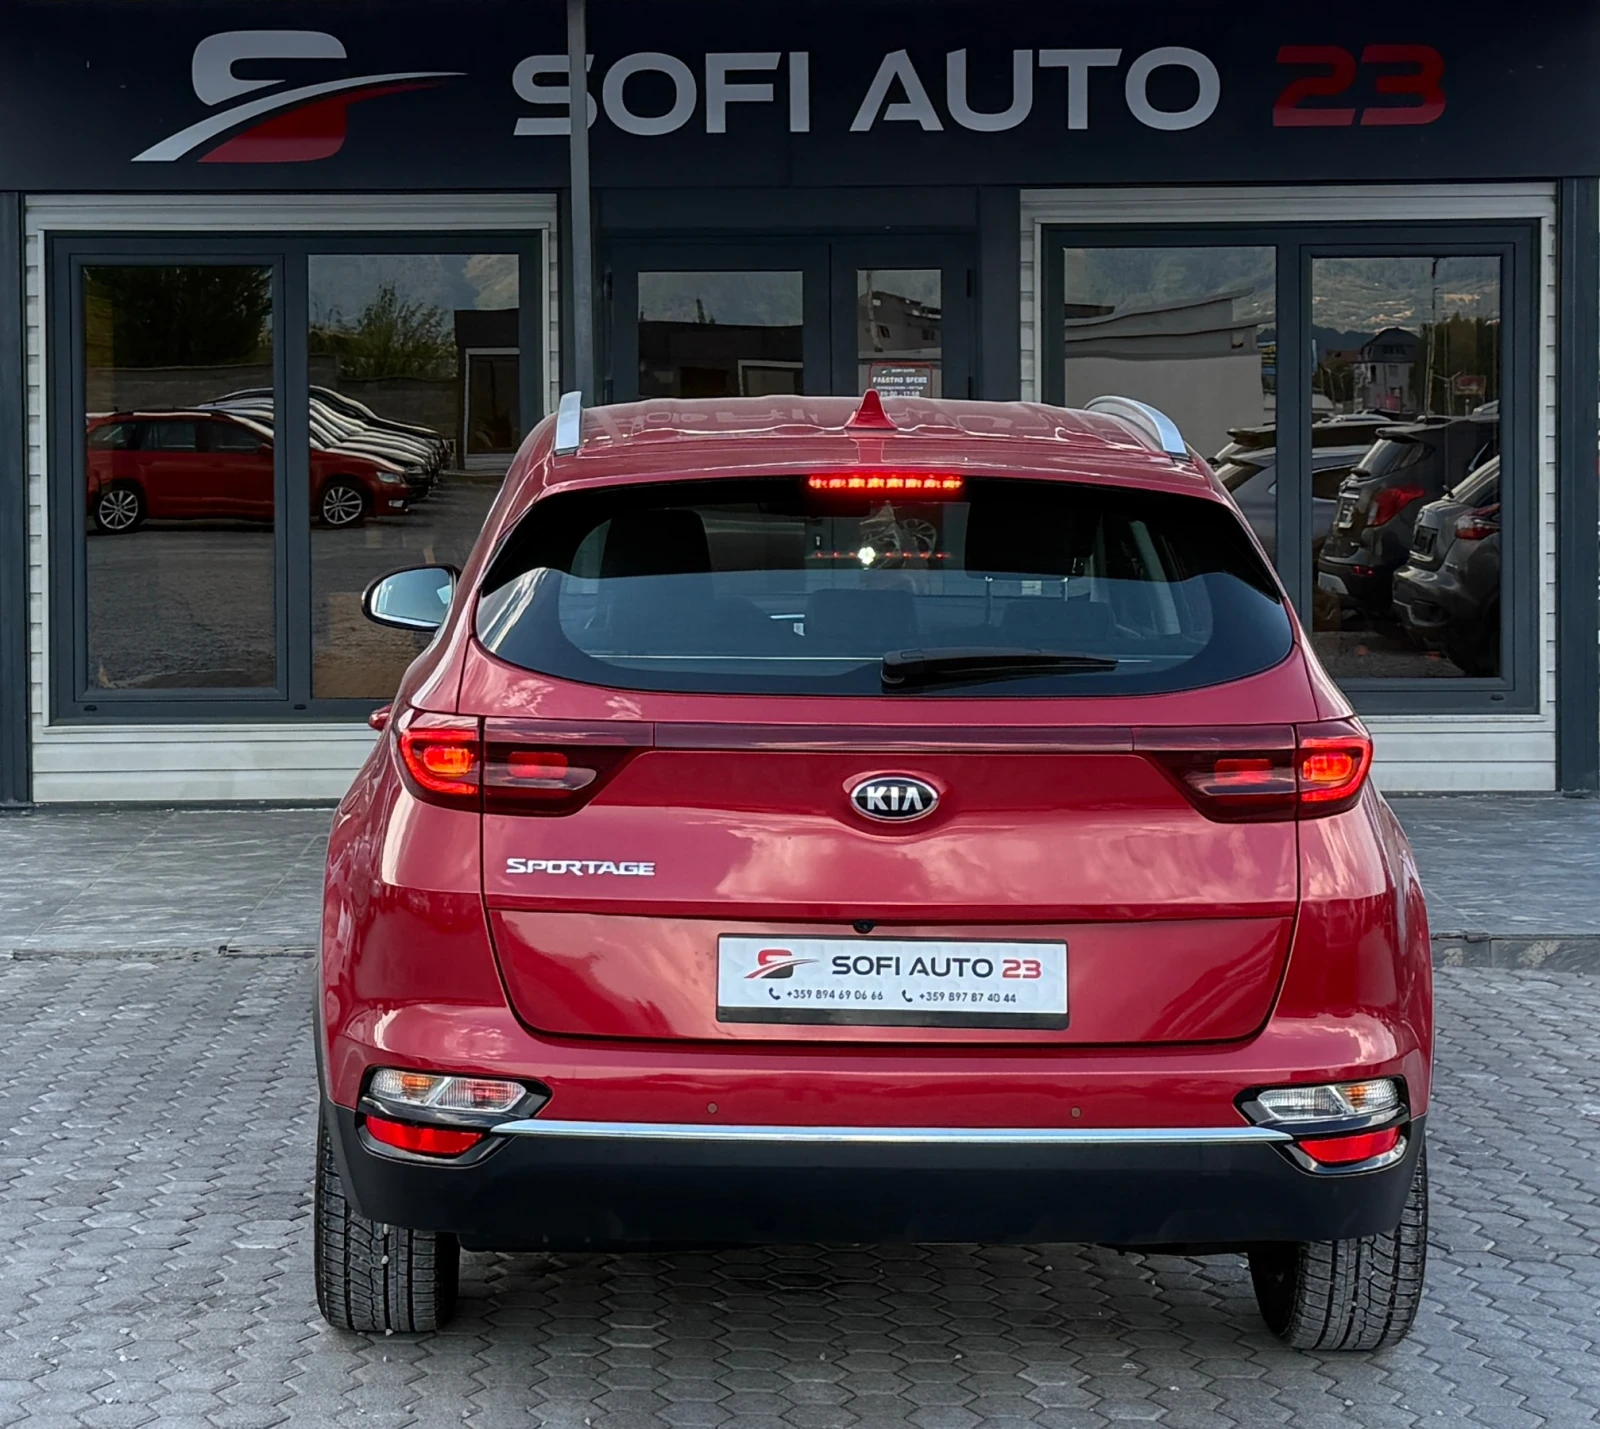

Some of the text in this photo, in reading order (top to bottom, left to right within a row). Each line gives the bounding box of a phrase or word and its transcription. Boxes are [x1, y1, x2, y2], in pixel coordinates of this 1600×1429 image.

[512, 45, 1447, 136] SOFI AUTO 23
[866, 786, 923, 811] KIA
[506, 858, 655, 876] SPORTAGE
[832, 955, 1042, 979] SOFI AUTO 23
[787, 989, 884, 1000] +359 894 69 06 66
[919, 991, 1017, 1003] +359 897 87 40 44
